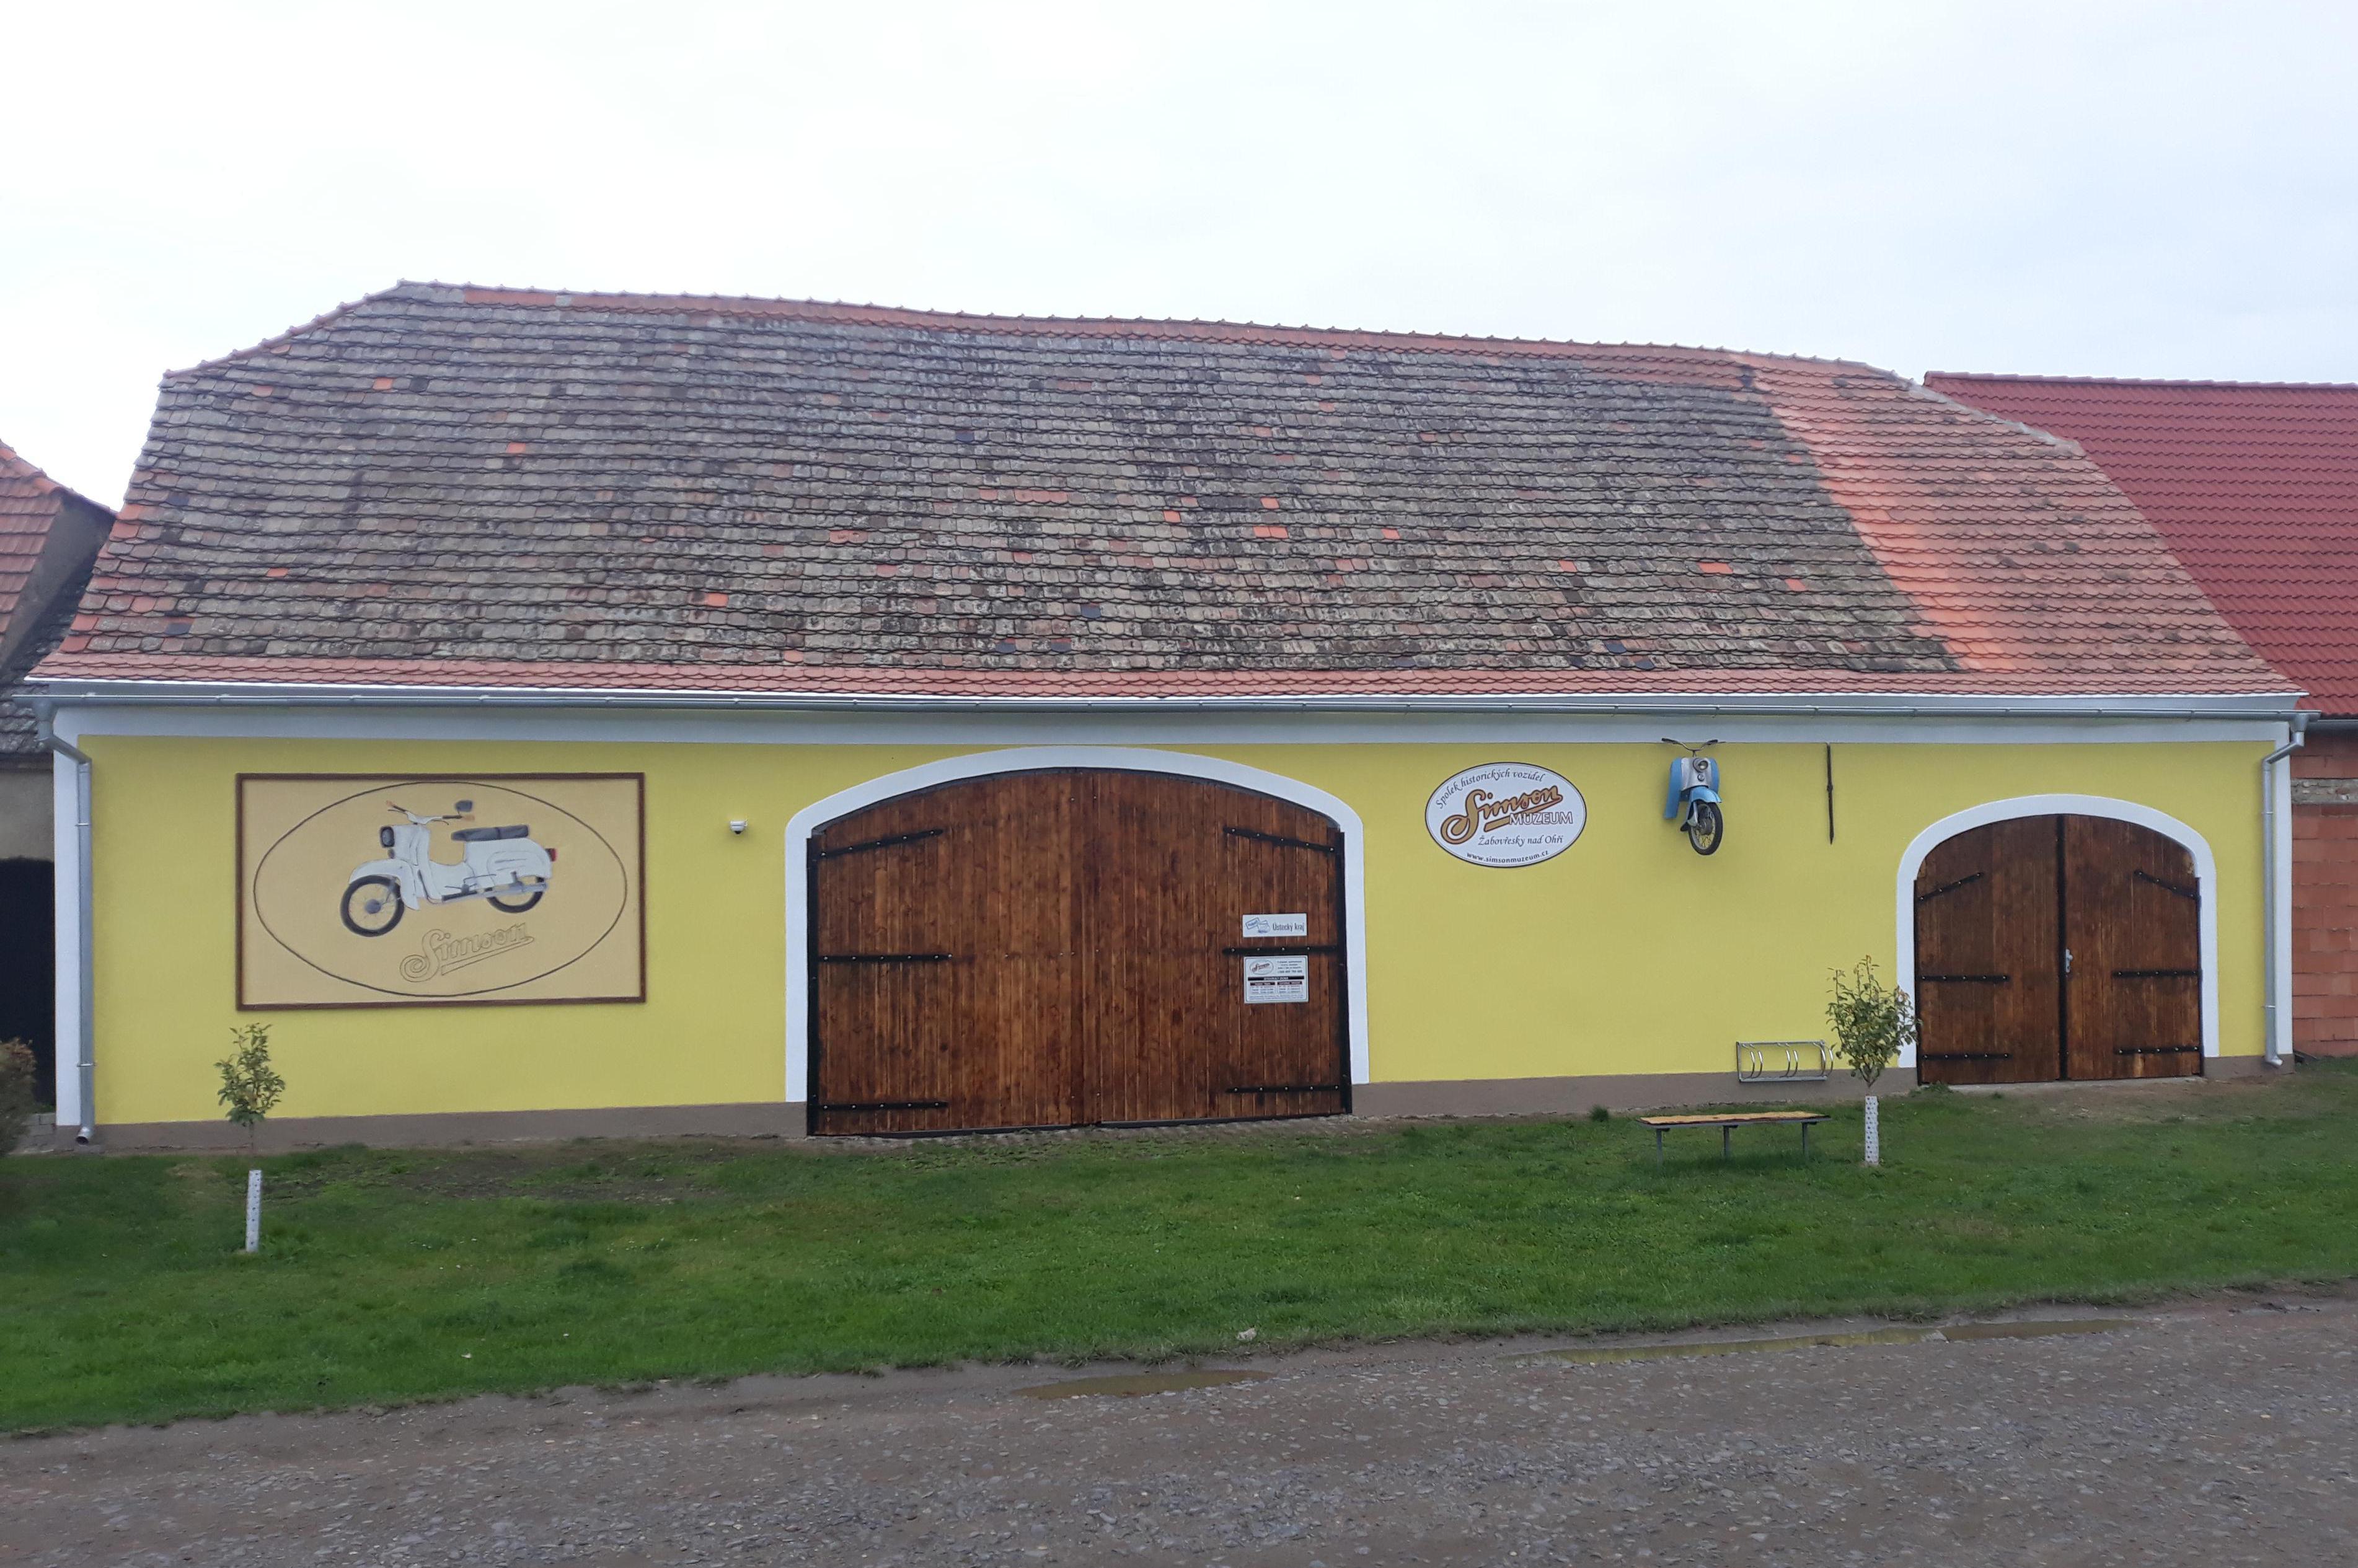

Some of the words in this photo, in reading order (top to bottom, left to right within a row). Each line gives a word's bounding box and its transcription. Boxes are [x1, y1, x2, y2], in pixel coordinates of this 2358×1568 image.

[1436, 782, 1463, 809] Spolek
[1460, 768, 1511, 788] historických
[1512, 773, 1545, 782] vozidel
[1441, 785, 1563, 845] Simson
[1509, 811, 1573, 825] MUZEUM
[1478, 834, 1526, 847] Žabovřesky
[1527, 834, 1542, 844] nad
[1467, 850, 1549, 863] www.simsonmuzeum.cz
[400, 922, 534, 982] Simson
